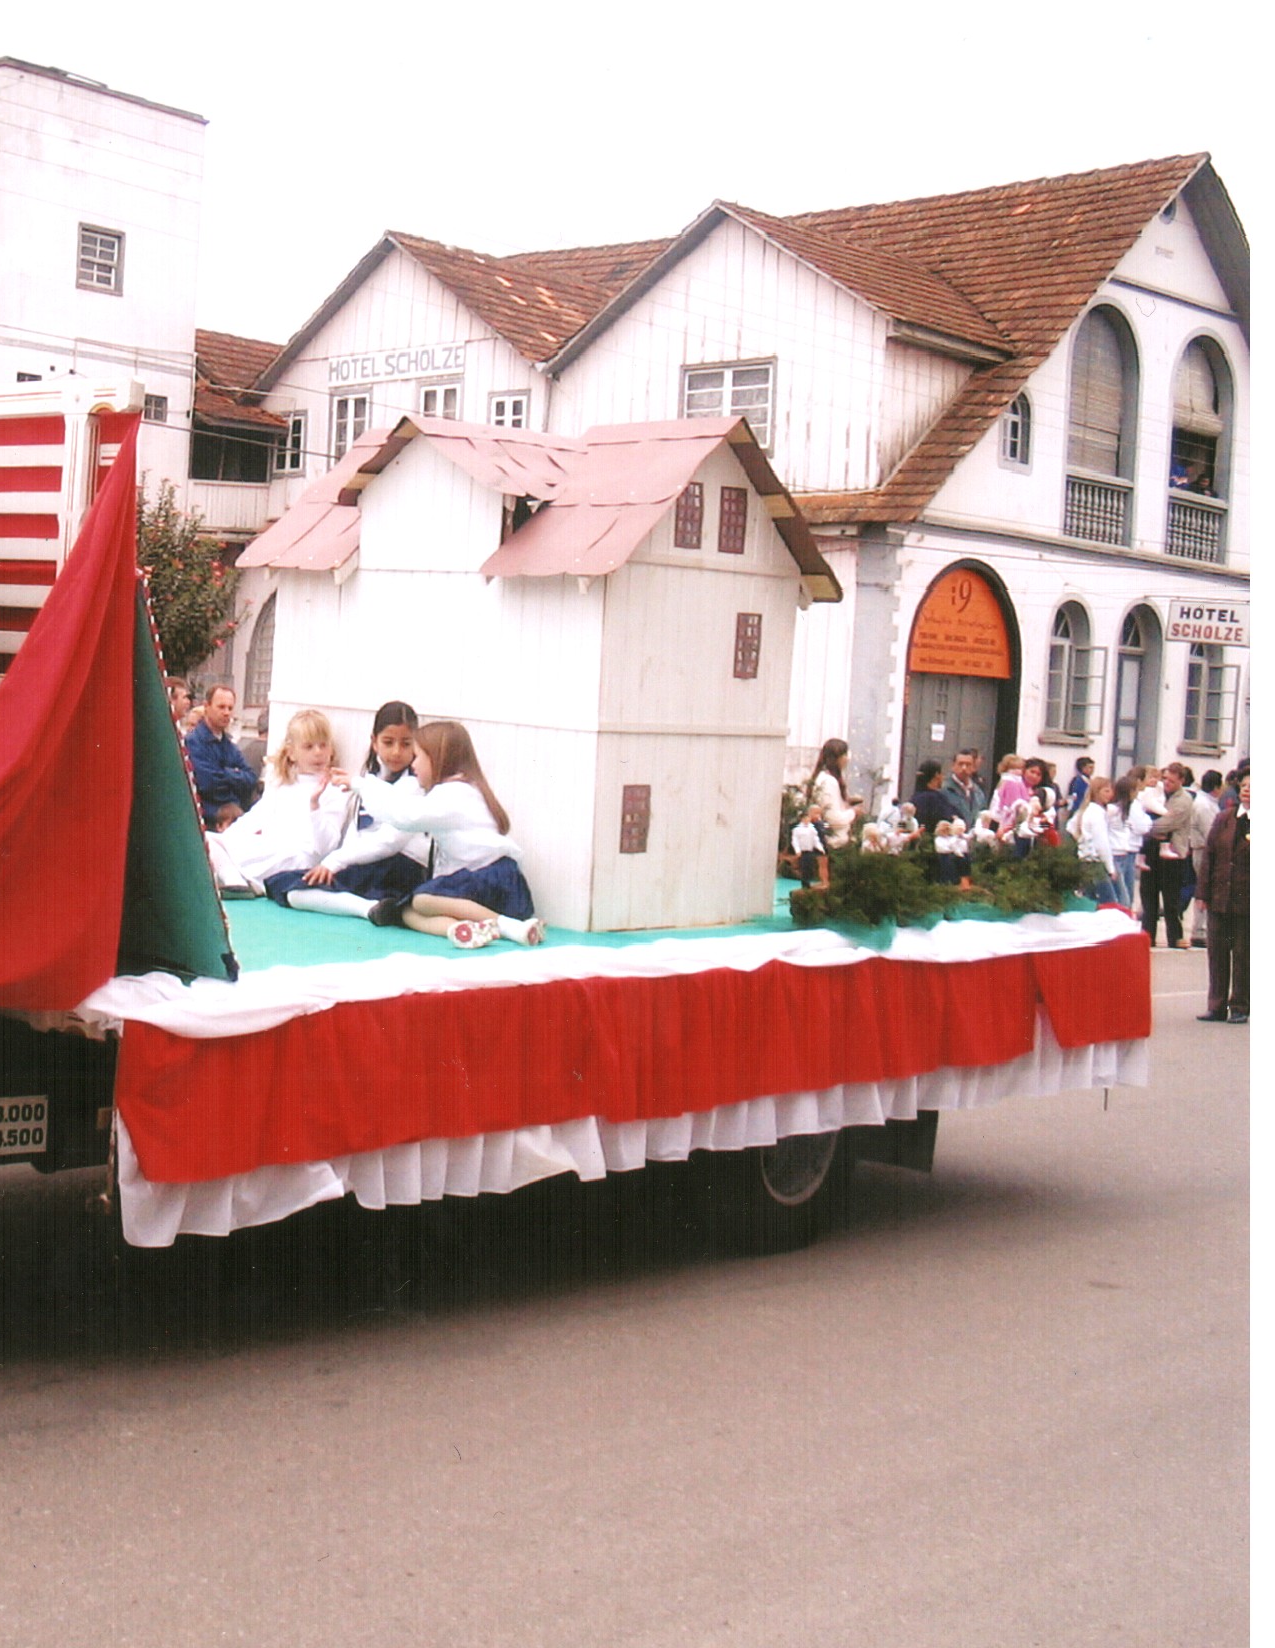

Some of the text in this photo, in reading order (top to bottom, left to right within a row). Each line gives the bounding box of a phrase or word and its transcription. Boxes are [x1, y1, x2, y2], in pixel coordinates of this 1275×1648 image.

[329, 347, 464, 382] HOTEL SCHOLZE
[1179, 606, 1240, 623] HOTEL
[1171, 622, 1243, 642] SCHOLZE
